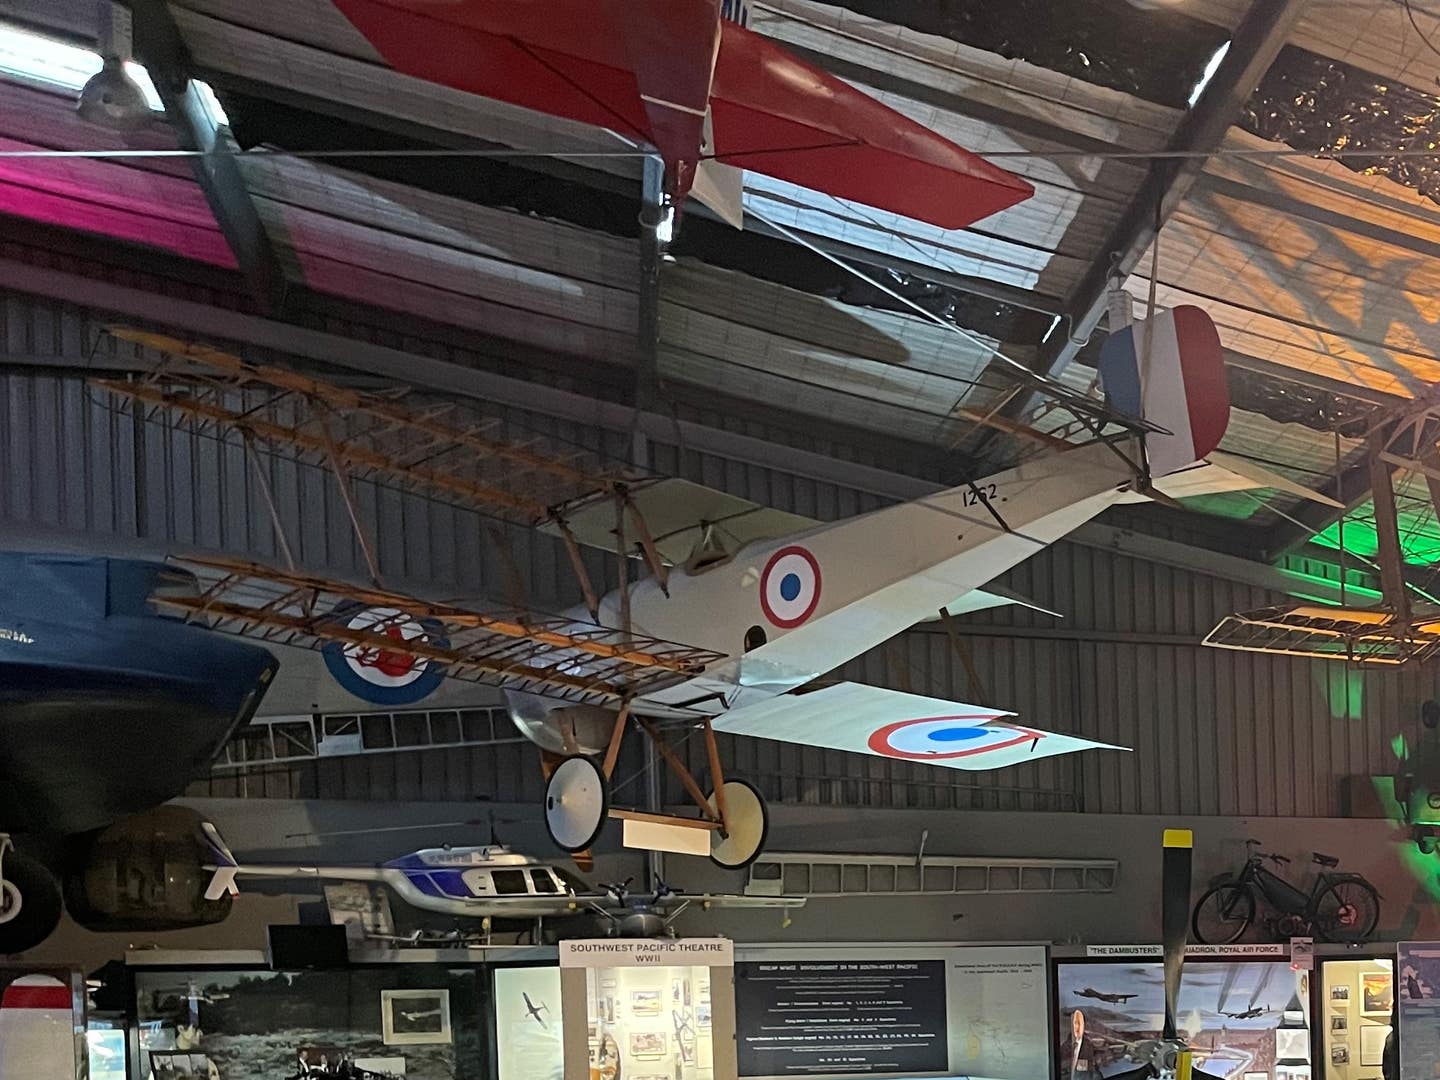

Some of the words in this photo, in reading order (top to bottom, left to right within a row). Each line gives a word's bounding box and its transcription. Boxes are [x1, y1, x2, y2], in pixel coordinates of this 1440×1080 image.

[570, 943, 635, 953] SOUTHWEST
[637, 943, 676, 952] PACIFIC
[679, 943, 723, 952] THEATRE
[1184, 946, 1217, 954] UADRON,
[1219, 945, 1240, 953] ROYAL
[1242, 945, 1254, 953] AIR
[1255, 945, 1279, 953] FORCE
[635, 954, 661, 962] WWII
